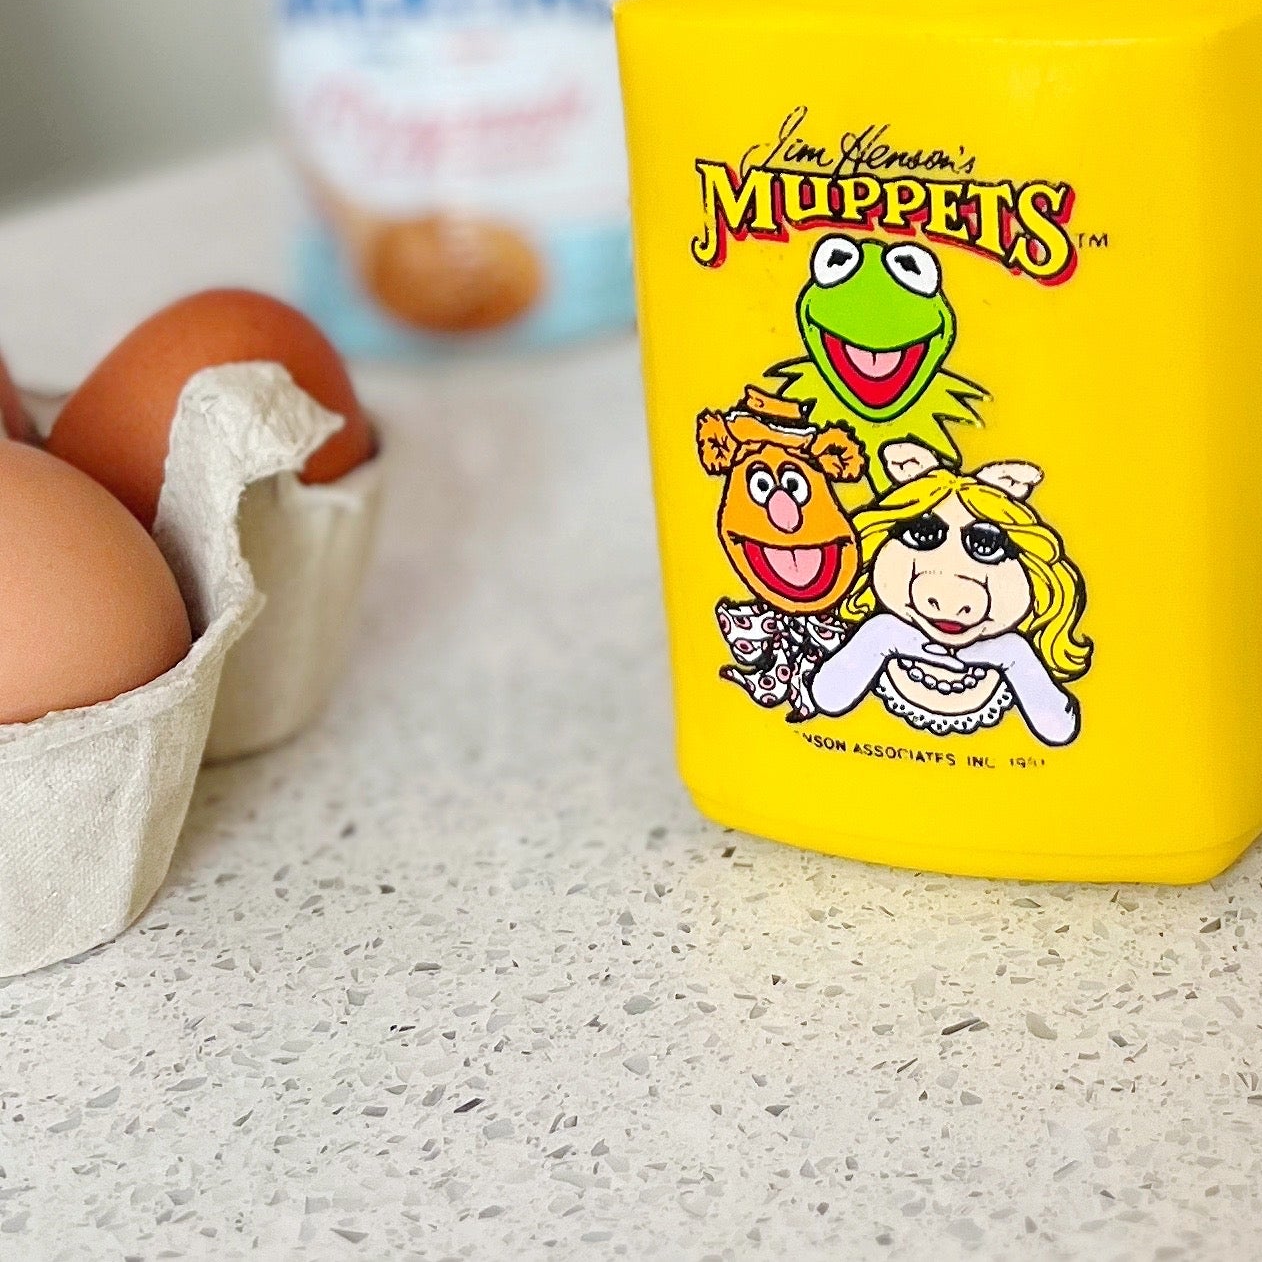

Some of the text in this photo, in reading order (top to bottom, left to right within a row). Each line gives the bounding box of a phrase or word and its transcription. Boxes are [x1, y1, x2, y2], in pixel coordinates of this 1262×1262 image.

[743, 105, 976, 177] Jim Henson's
[692, 158, 1076, 286] MUPPETS
